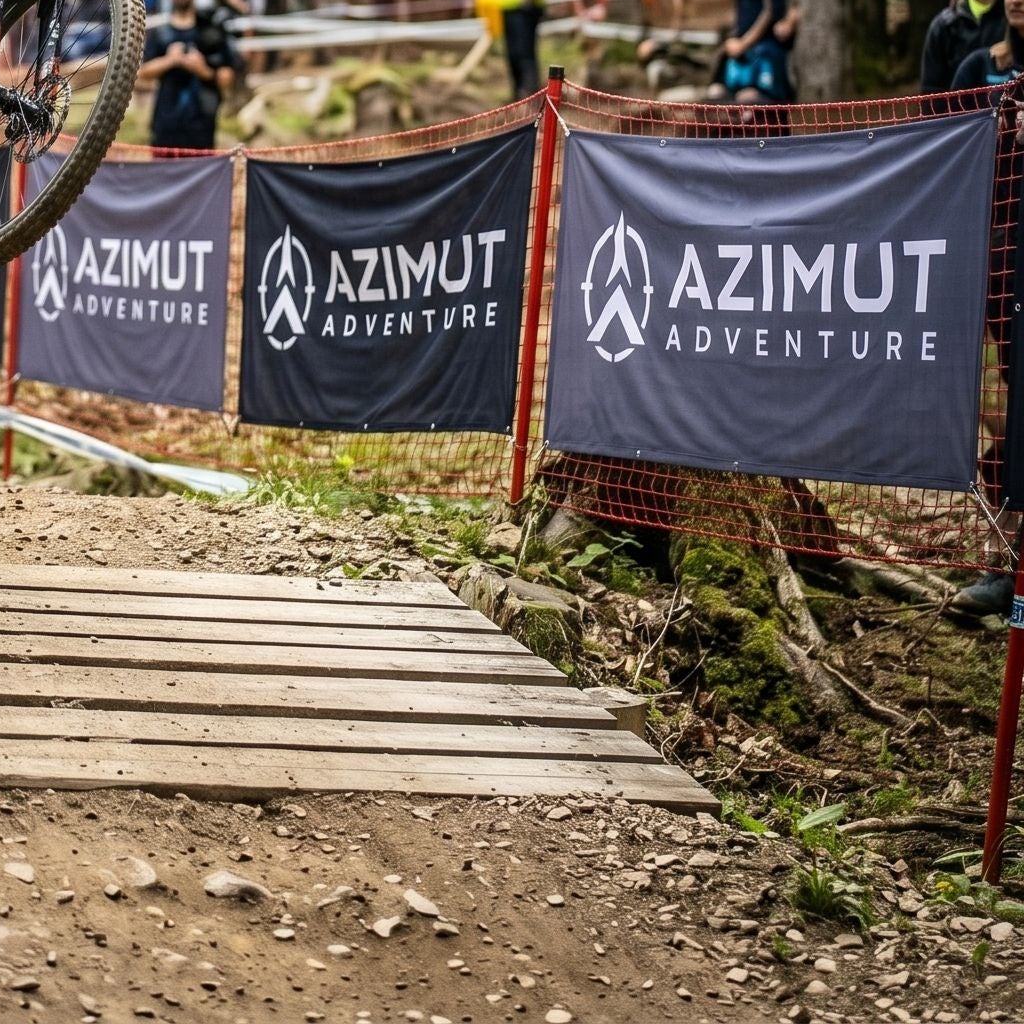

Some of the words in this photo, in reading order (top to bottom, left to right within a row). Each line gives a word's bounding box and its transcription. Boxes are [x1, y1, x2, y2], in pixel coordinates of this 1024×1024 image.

[73, 238, 213, 292] AZIMUT
[324, 229, 506, 304] AZIMUT
[668, 239, 947, 314] AZIMUT
[72, 294, 209, 327] ADVENTURE
[321, 302, 498, 338] ADVENTURE
[665, 324, 937, 362] ADVENTURE
